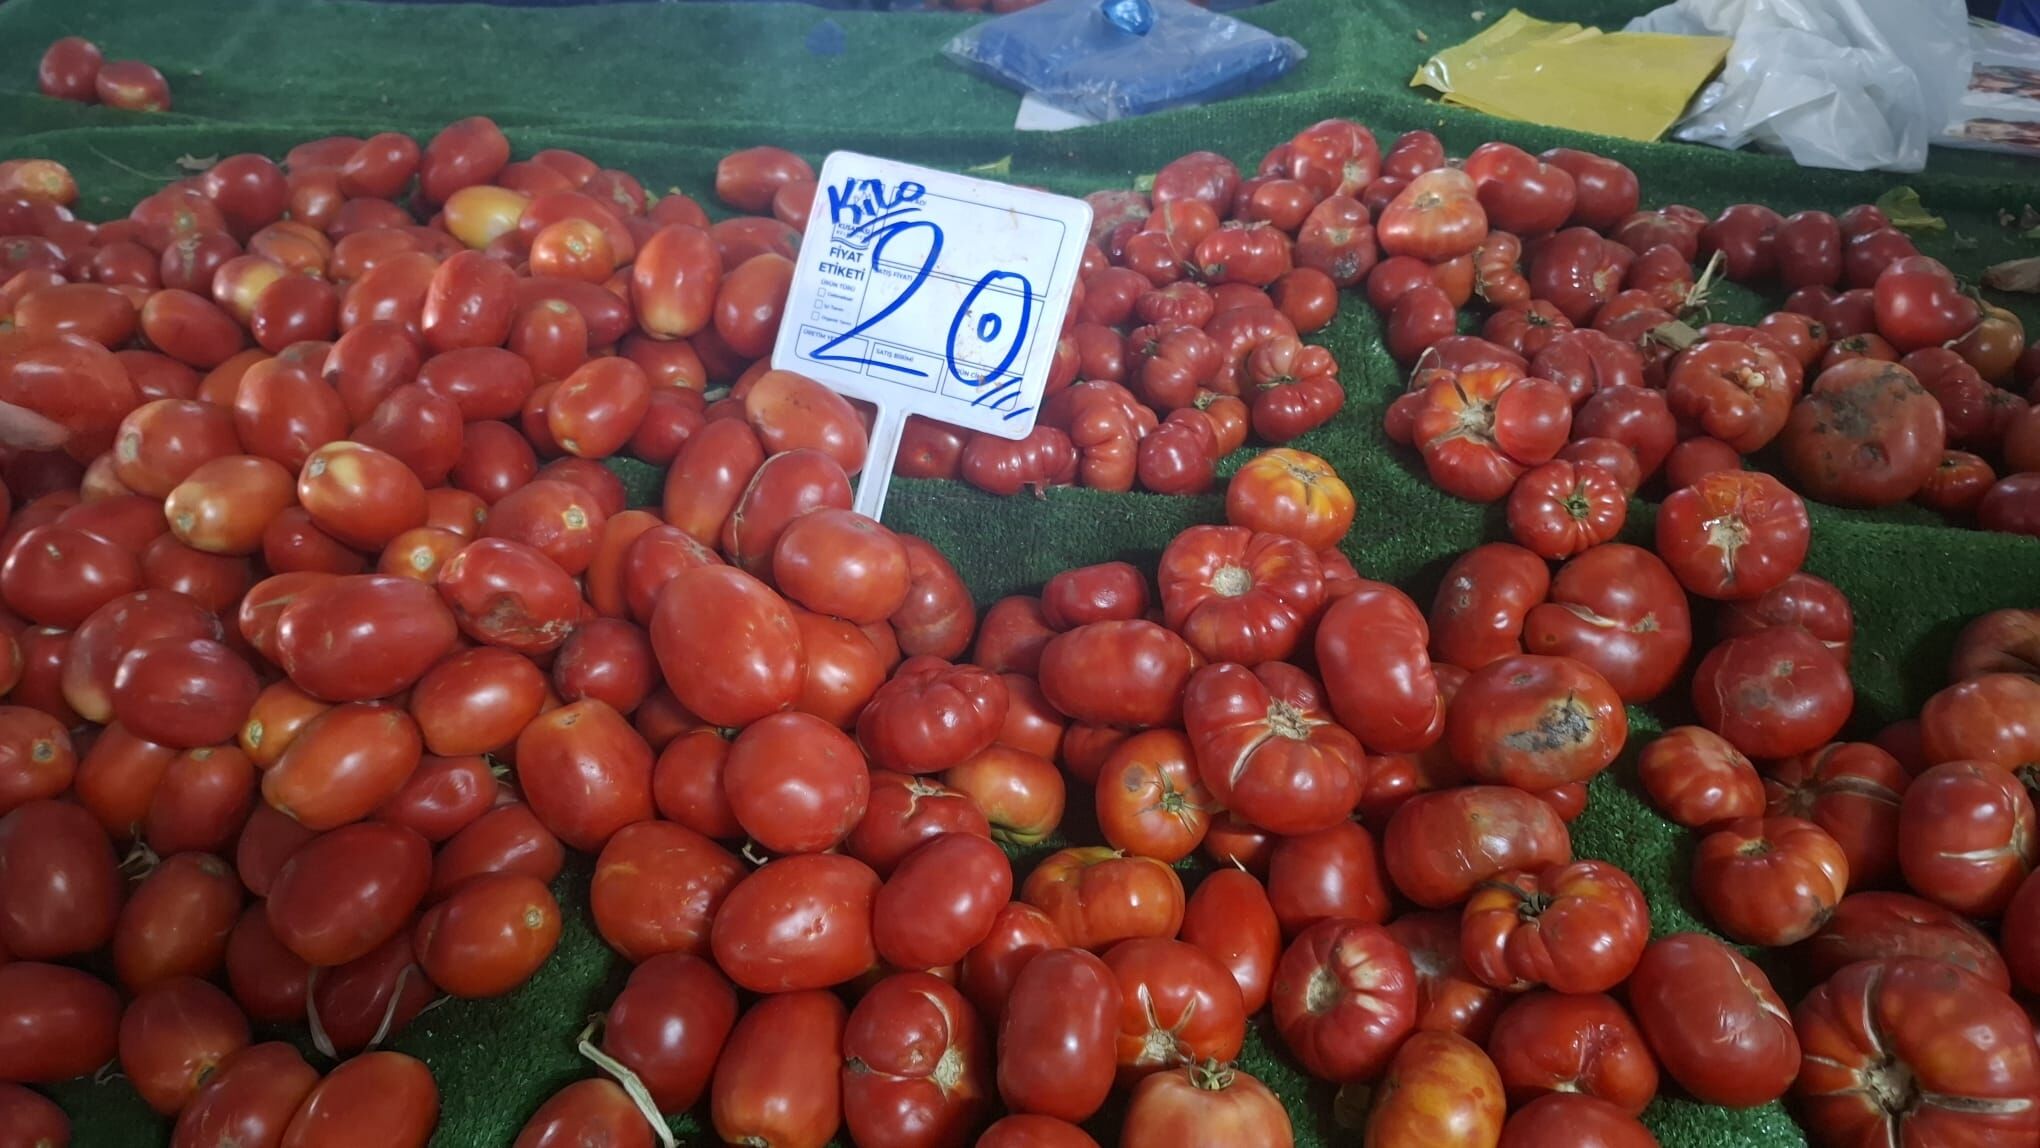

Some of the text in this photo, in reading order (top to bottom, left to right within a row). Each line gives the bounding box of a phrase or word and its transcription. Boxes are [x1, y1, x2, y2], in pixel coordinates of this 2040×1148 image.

[829, 245, 864, 264] FİYAT
[818, 261, 866, 281] ETİKETİ
[809, 221, 1032, 387] 20
